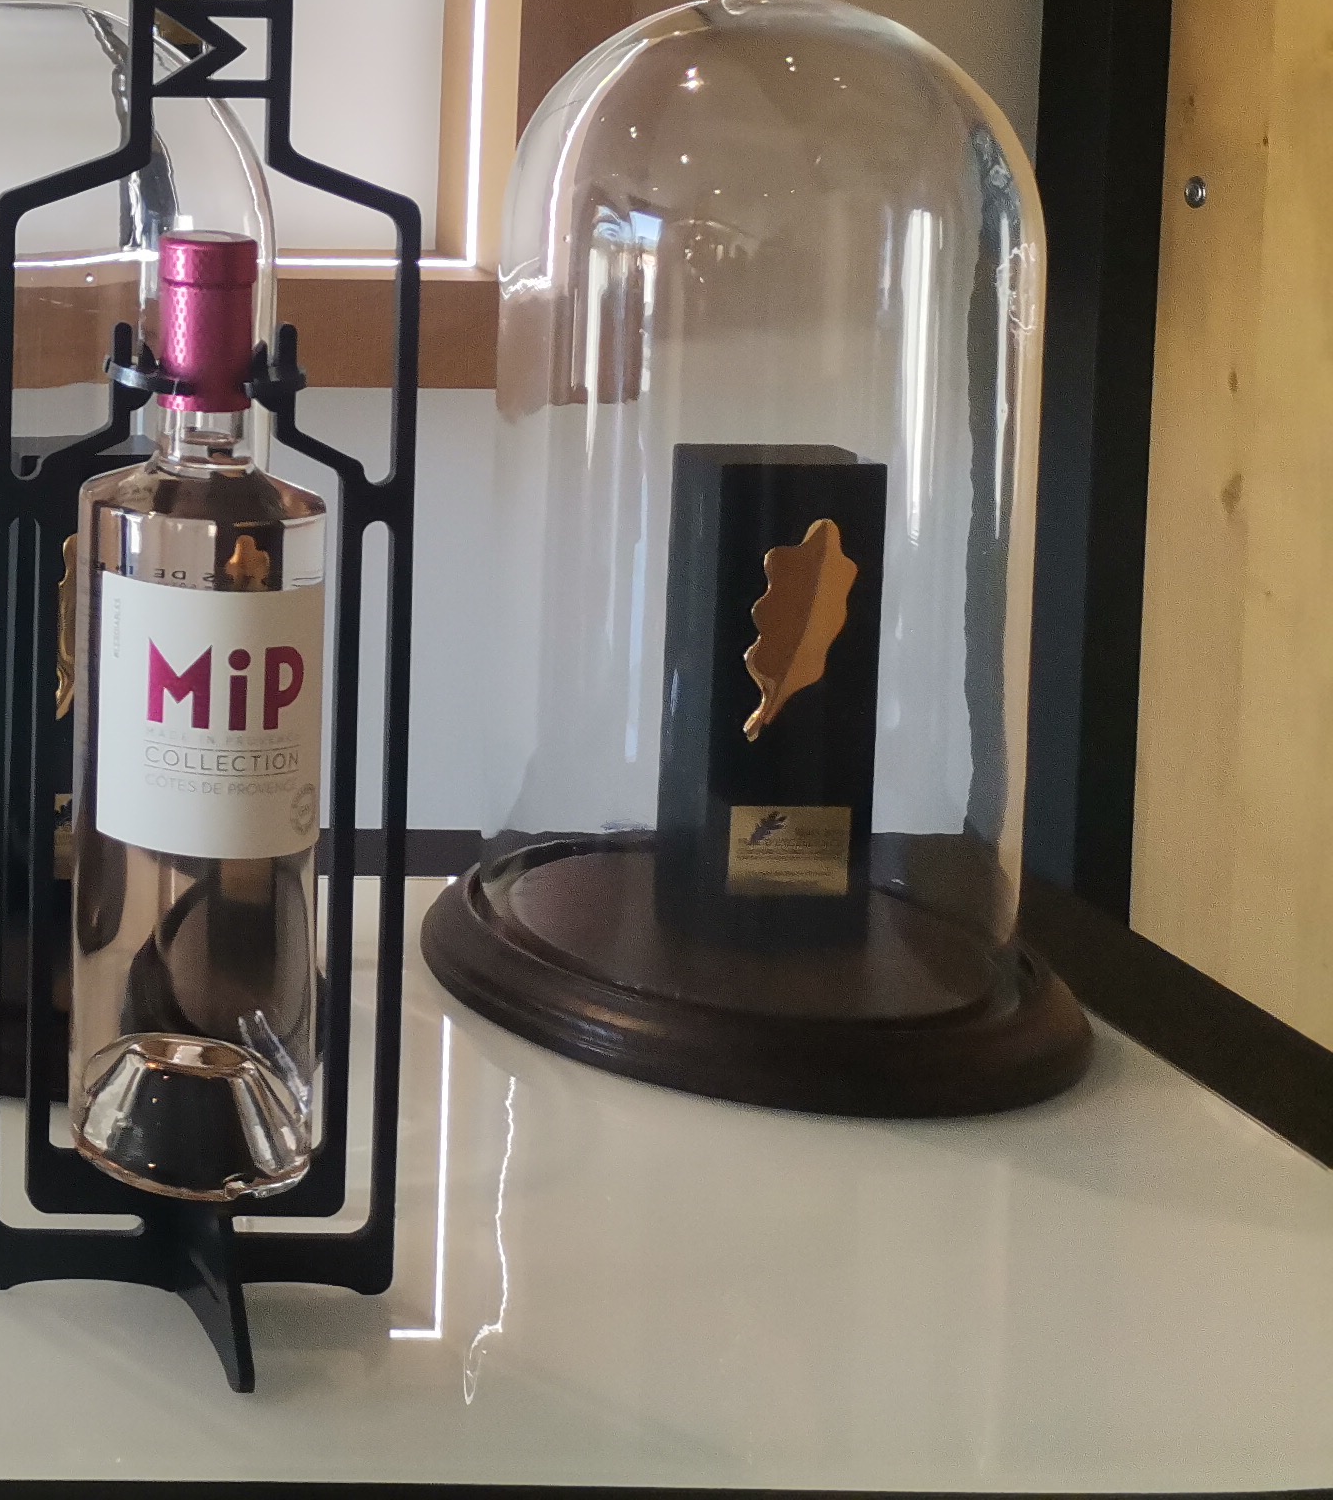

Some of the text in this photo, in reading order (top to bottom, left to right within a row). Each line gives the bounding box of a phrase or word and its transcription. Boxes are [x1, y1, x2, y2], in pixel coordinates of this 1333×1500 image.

[146, 637, 305, 731] MiP
[145, 745, 300, 773] COLLECTION
[201, 781, 223, 796] DE
